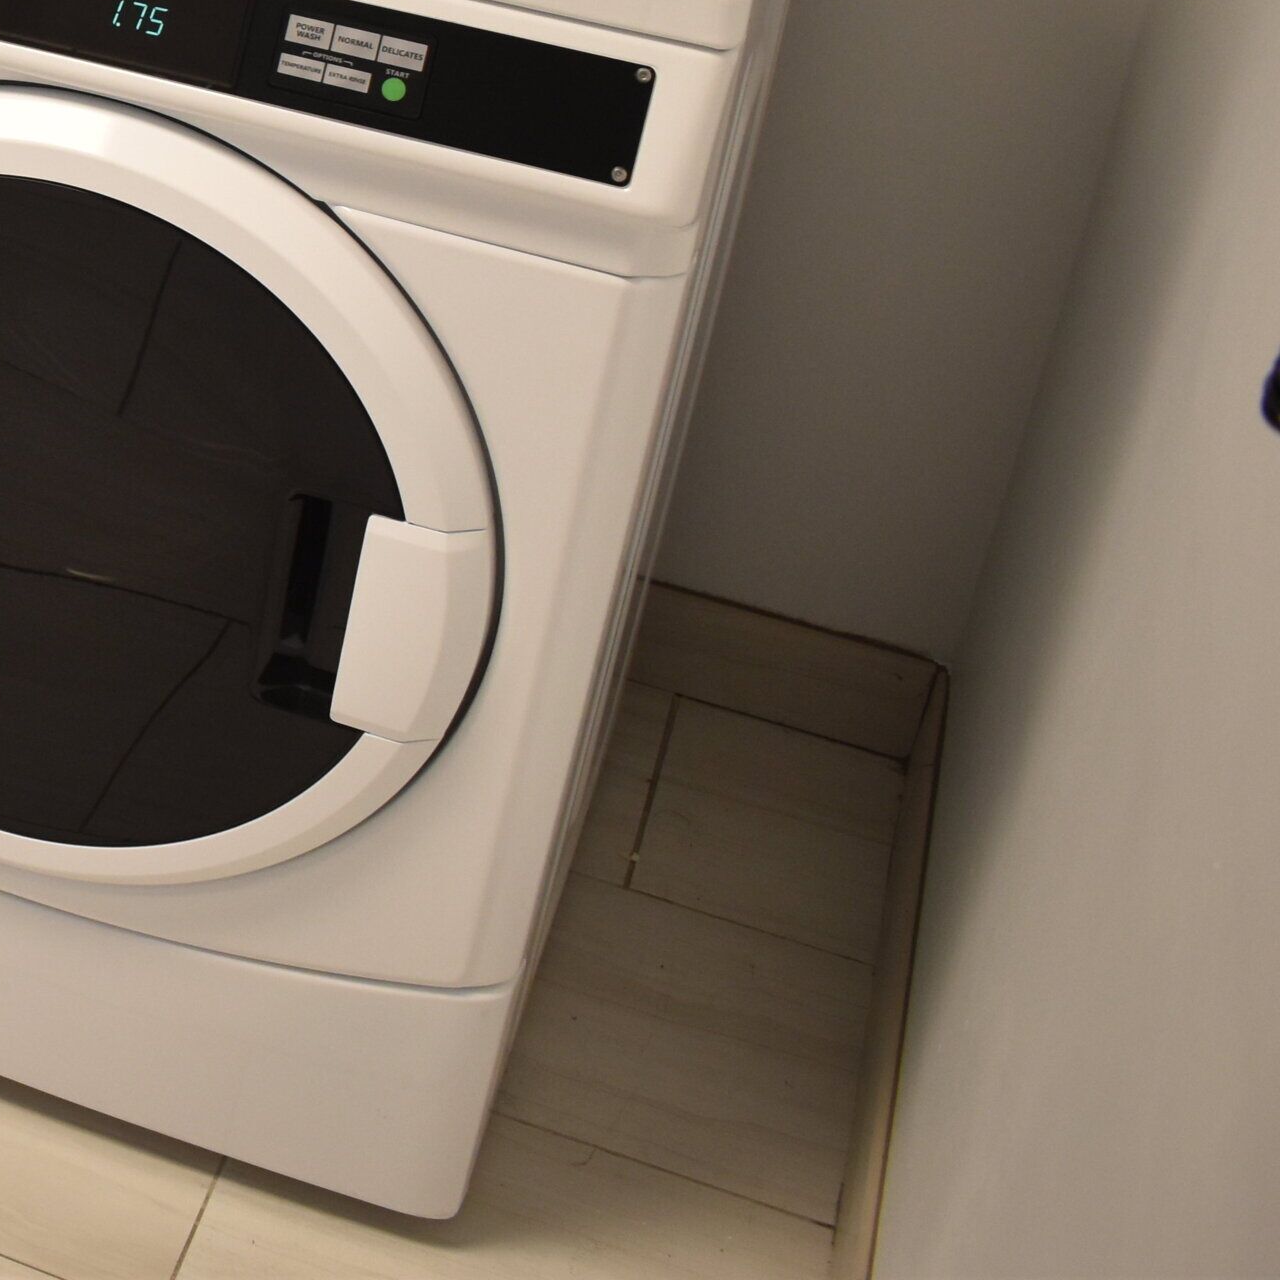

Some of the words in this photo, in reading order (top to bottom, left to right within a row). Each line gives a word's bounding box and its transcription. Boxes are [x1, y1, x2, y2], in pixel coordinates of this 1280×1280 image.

[112, 0, 168, 36] 1.75
[295, 22, 326, 35] POWER
[296, 30, 321, 41] WASH
[337, 35, 374, 50] NORMAL
[312, 51, 343, 63] OPTIONS
[381, 45, 424, 61] DELICATES
[281, 60, 322, 74] TEMPERATURE
[385, 68, 411, 79] START
[328, 71, 348, 81] EXTRA
